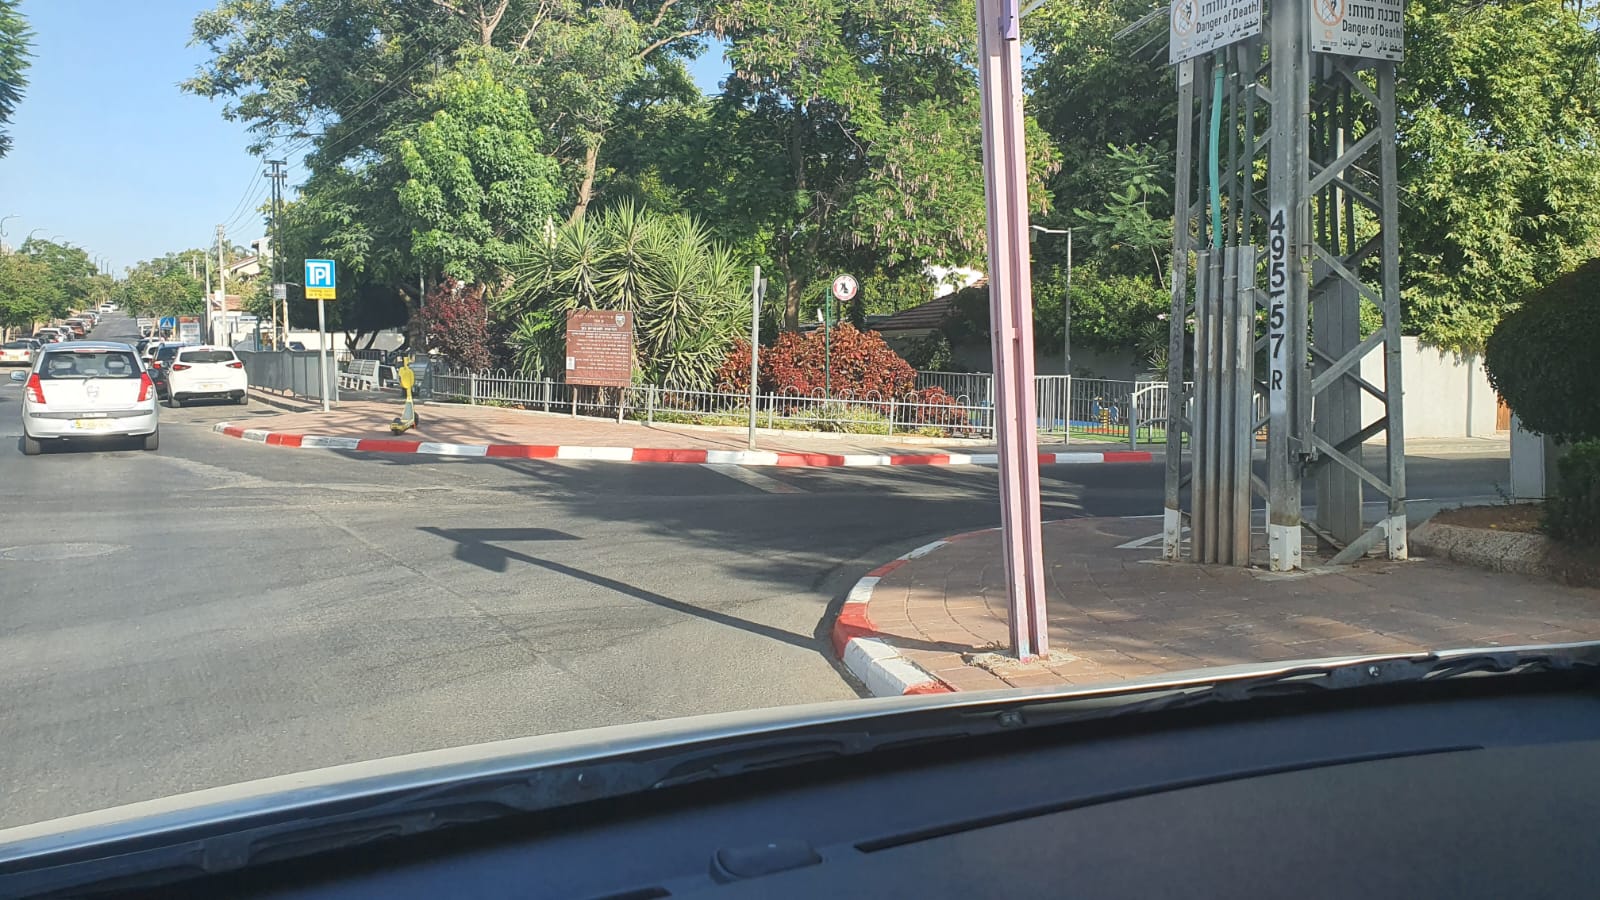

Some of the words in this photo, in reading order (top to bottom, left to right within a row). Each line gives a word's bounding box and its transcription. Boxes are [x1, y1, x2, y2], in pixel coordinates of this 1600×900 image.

[1349, 4, 1374, 19] מוות!
[1378, 8, 1400, 23] סכנת
[1196, 17, 1222, 34] Danger
[1223, 9, 1232, 24] of
[1342, 19, 1369, 36] Danger
[1371, 23, 1379, 36] of
